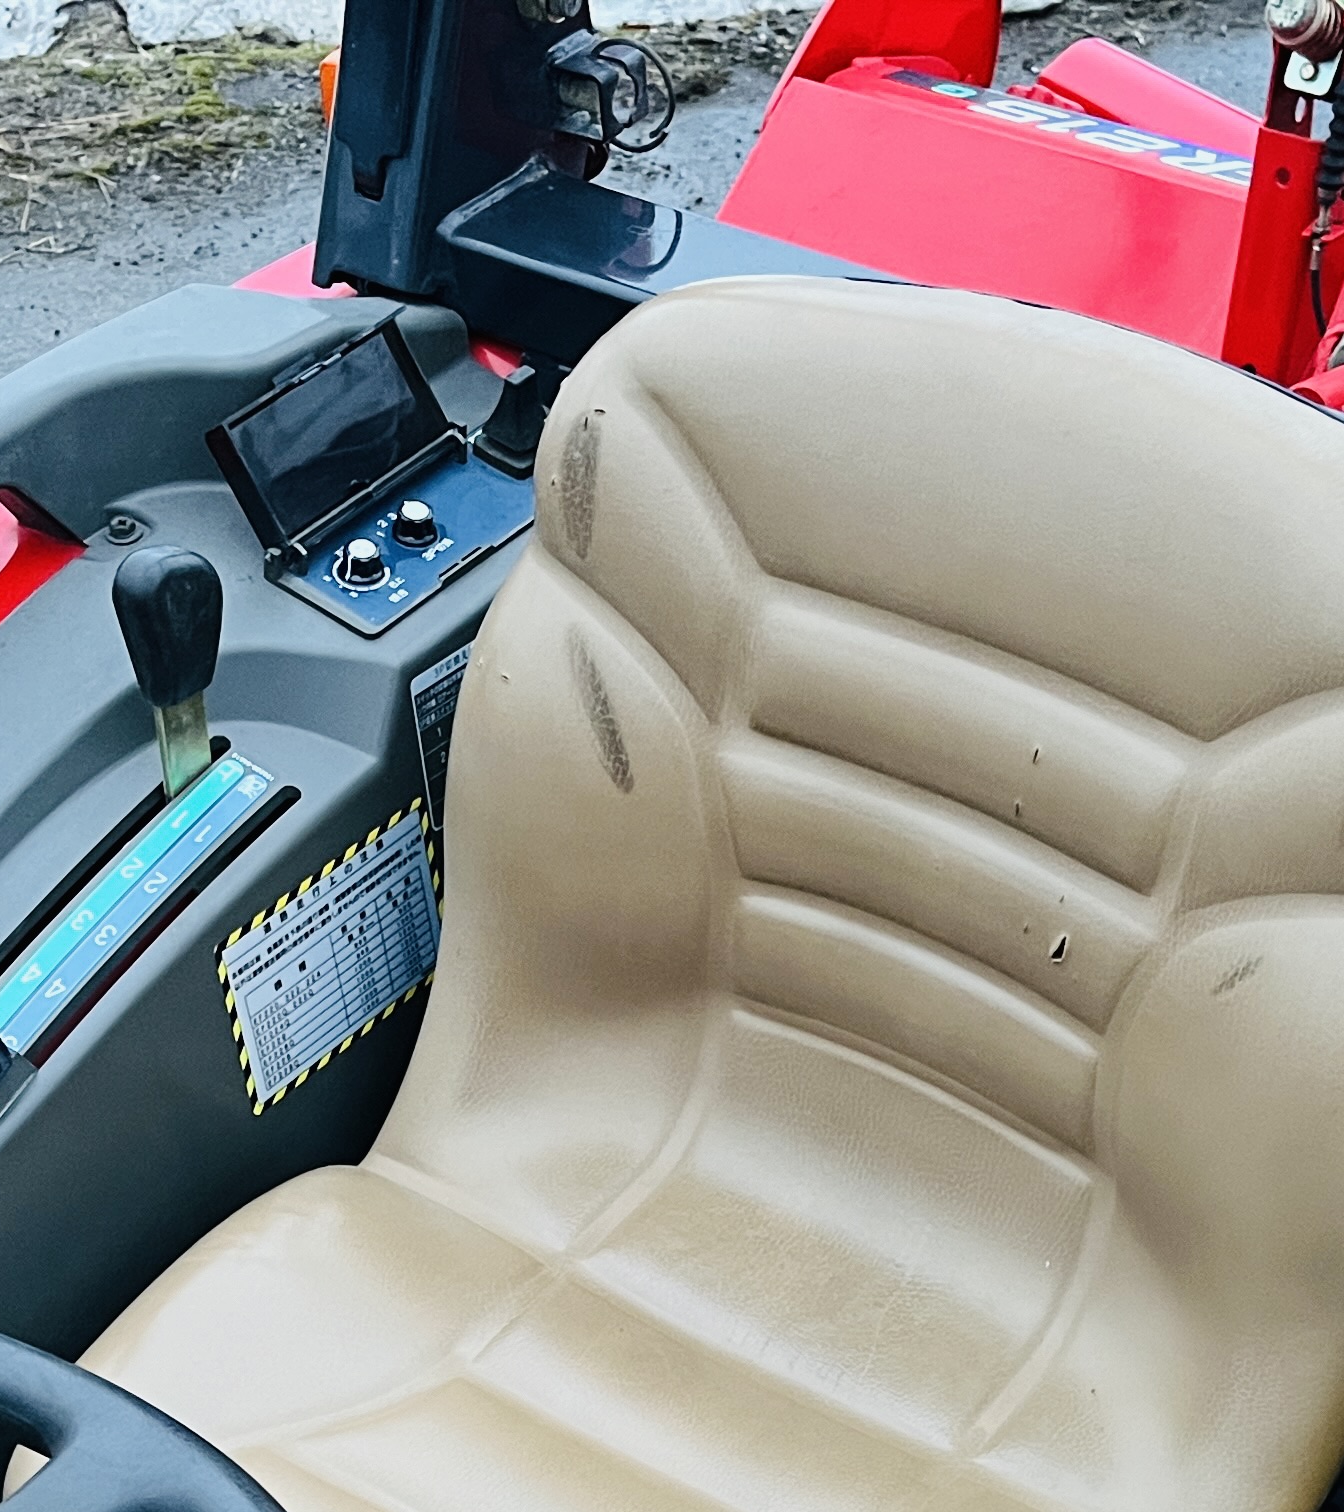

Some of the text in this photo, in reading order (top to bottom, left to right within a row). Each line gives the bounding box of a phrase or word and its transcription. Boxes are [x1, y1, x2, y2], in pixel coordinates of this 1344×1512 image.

[171, 810, 188, 828] 1
[194, 825, 212, 843] 1
[120, 858, 144, 878] 2
[144, 872, 168, 893] 2
[71, 909, 94, 931] 3
[94, 924, 117, 946] 3
[21, 962, 42, 983] 4
[45, 978, 67, 998] 4
